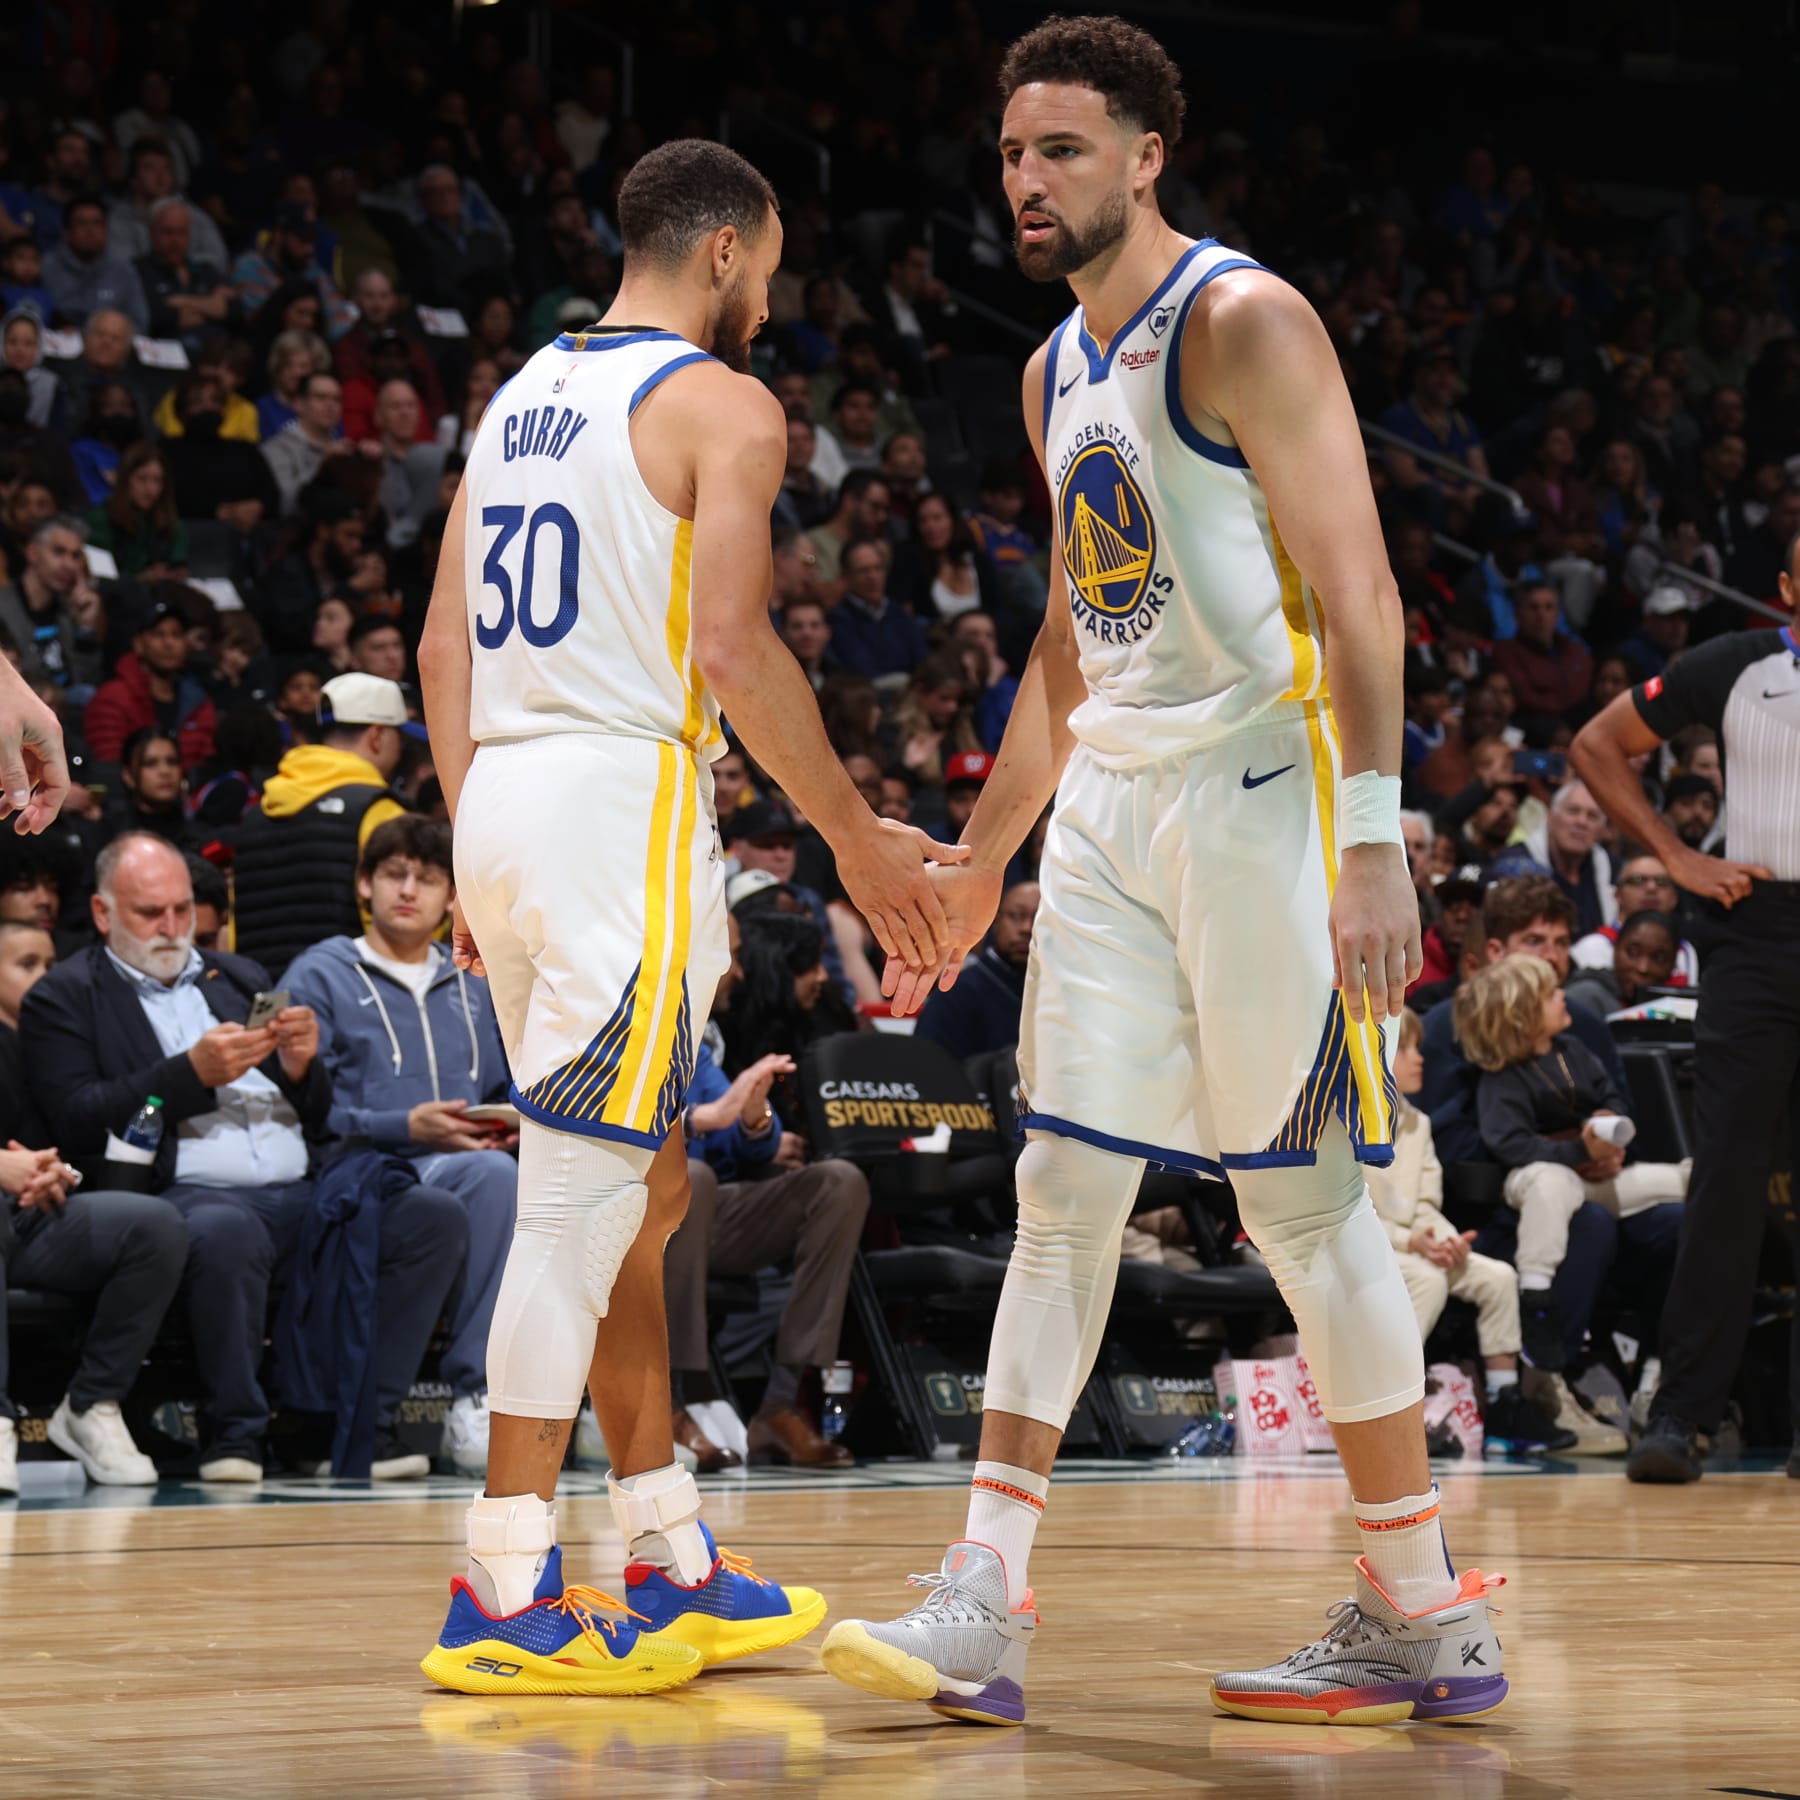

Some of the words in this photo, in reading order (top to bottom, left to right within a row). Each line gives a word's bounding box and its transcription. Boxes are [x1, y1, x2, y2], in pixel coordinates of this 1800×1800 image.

[1120, 349, 1161, 367] Rakuten
[503, 405, 588, 463] CURRY
[1055, 421, 1105, 487] GOLDEN
[1108, 423, 1140, 472] STATE
[475, 502, 581, 650] 30
[1070, 572, 1175, 645] WARRIORS
[819, 1080, 919, 1100] CAESARS
[971, 1479, 1028, 1500] AUTHEN
[1384, 1517, 1417, 1530] NBA
